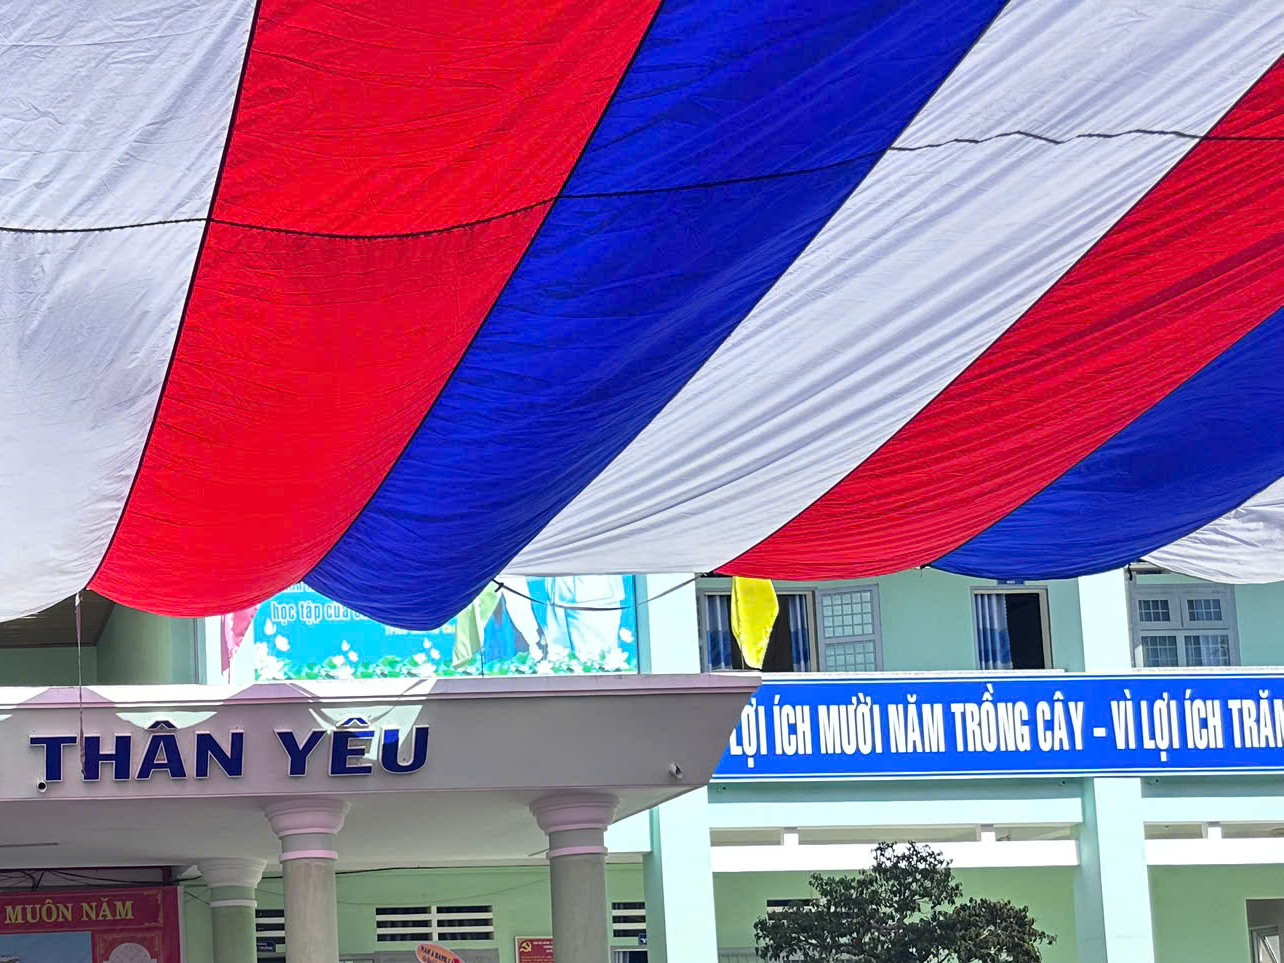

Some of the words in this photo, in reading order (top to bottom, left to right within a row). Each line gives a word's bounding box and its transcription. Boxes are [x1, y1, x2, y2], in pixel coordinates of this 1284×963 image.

[271, 602, 295, 624] học
[300, 602, 321, 623] tập
[773, 695, 813, 755] ÍCH
[817, 693, 883, 754] MƯỜI
[887, 694, 946, 753] NĂM
[950, 683, 1031, 752] TRỒNG
[1035, 691, 1084, 751] CÂY
[1110, 689, 1136, 750] VÌ
[1140, 692, 1180, 762] LỢI
[1184, 689, 1223, 750] ÍCH
[29, 719, 245, 783] THÂN
[274, 715, 431, 777] YÊU
[4, 900, 73, 924] MUÔN
[81, 897, 134, 920] NĂM
